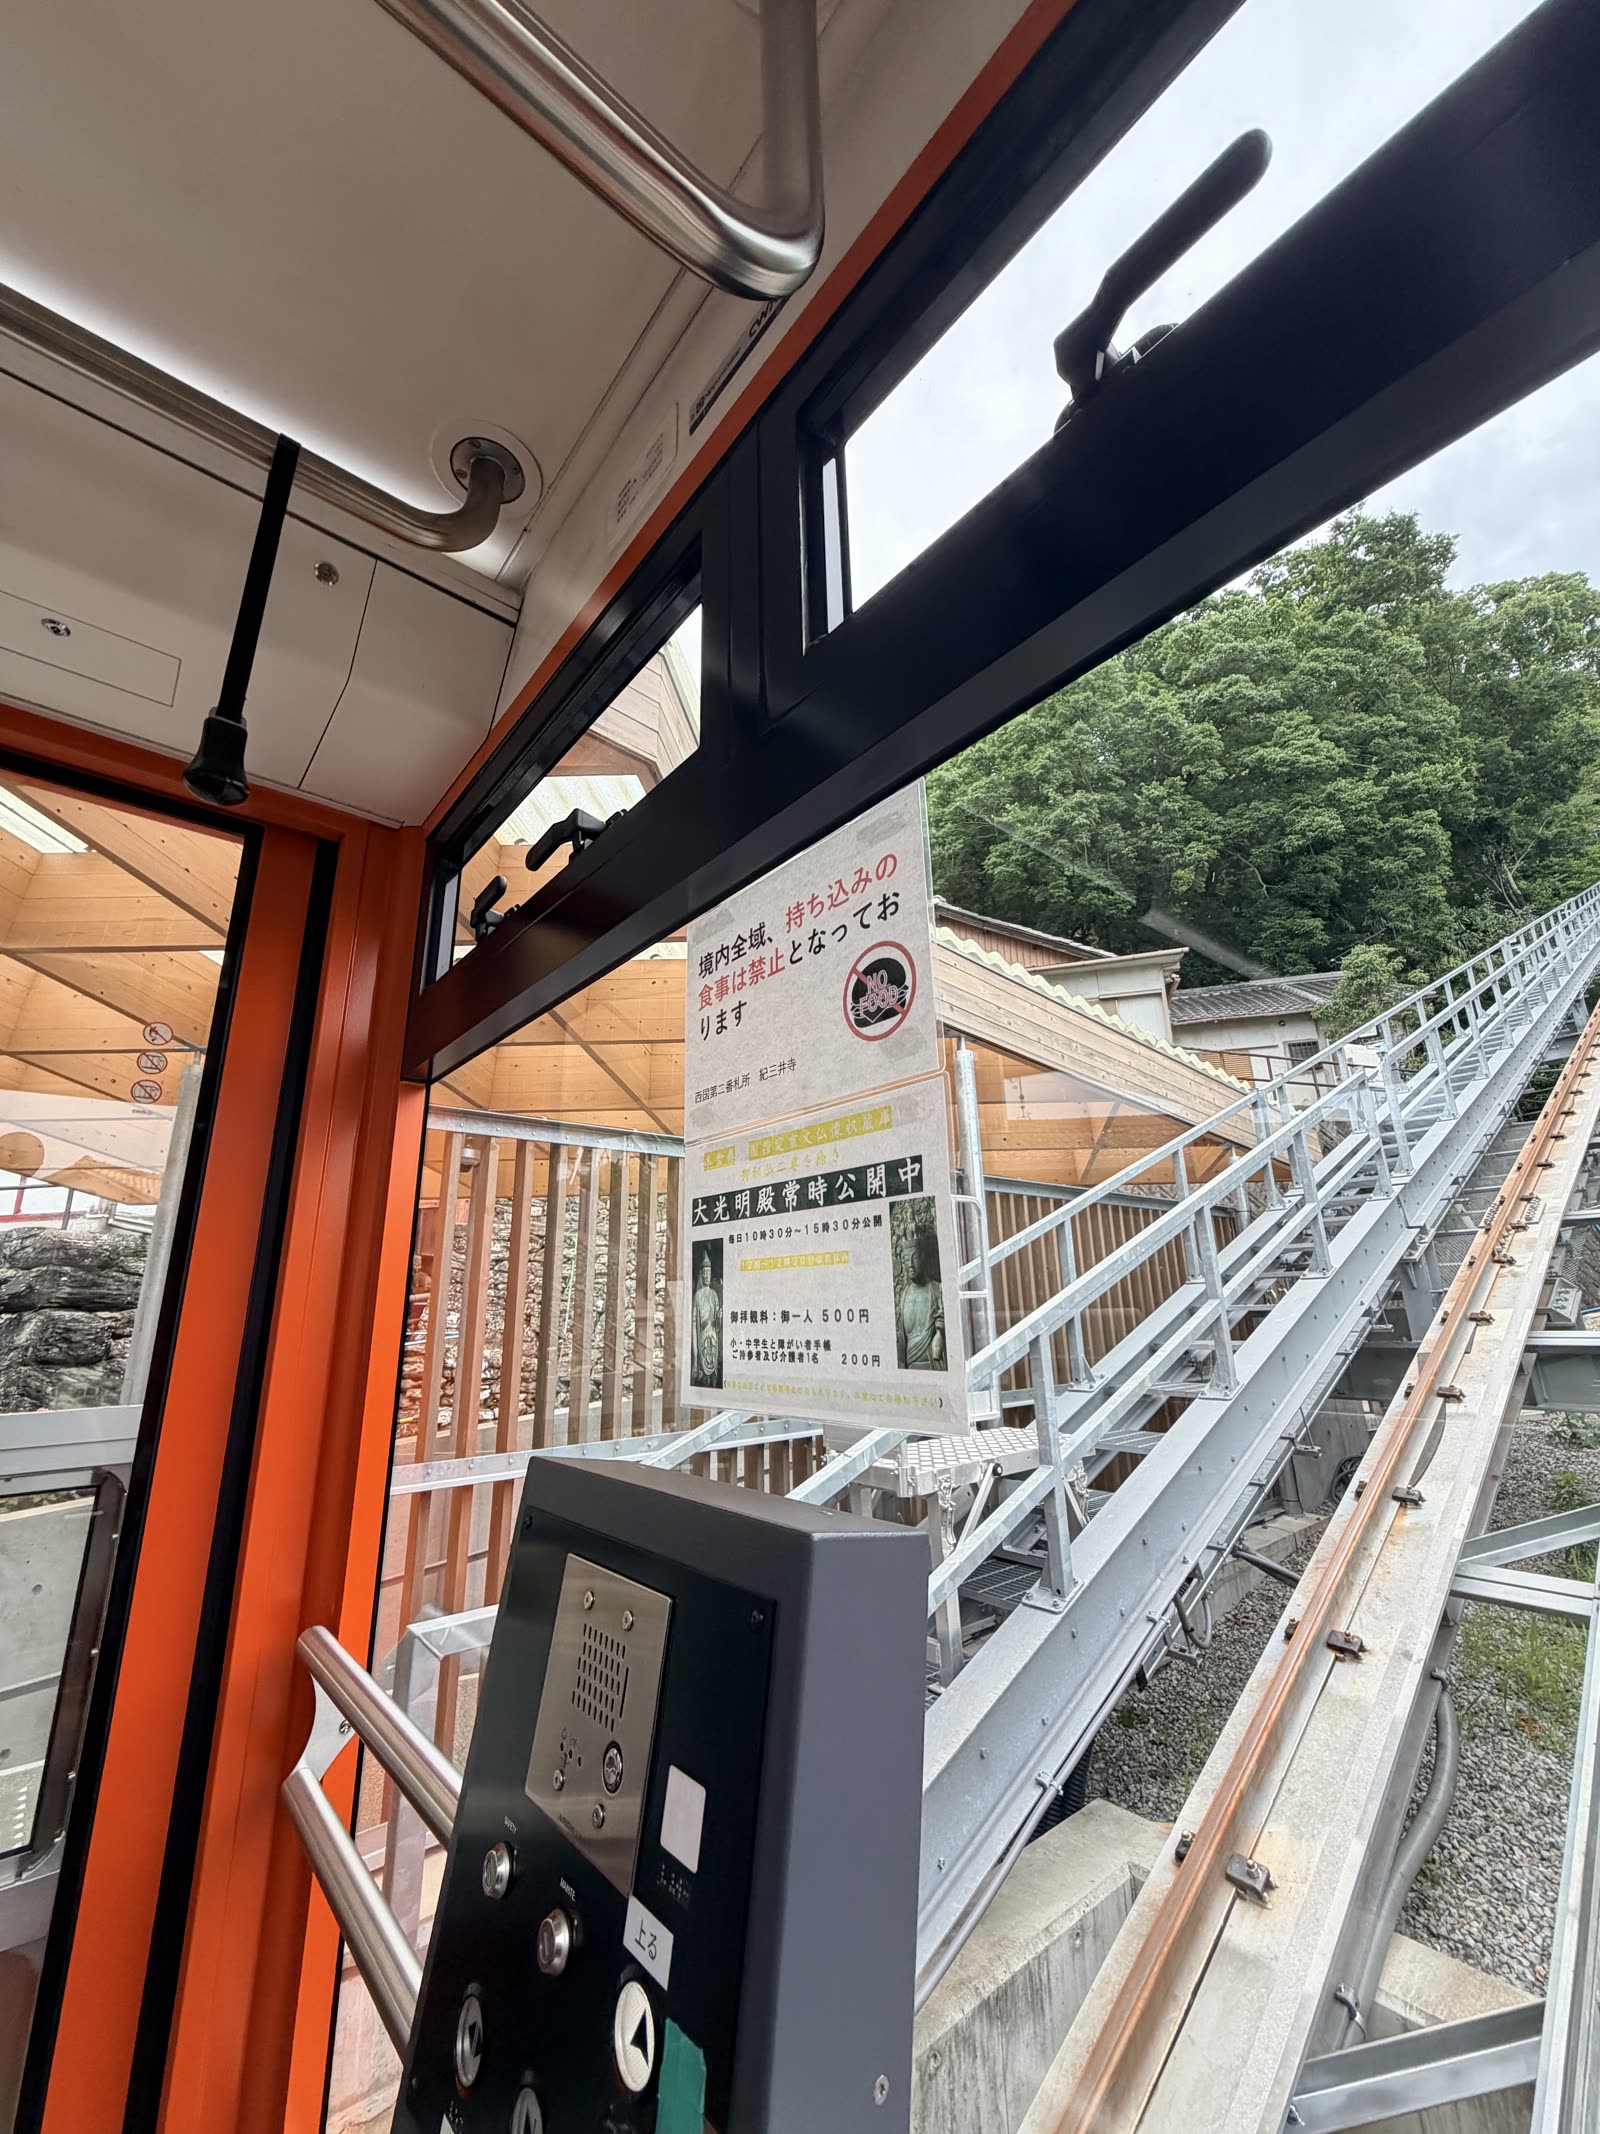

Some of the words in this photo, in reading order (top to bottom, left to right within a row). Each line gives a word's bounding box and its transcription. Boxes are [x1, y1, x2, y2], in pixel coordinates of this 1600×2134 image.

[698, 853, 898, 979] 境内全域、持ち込みの
[698, 892, 901, 1012] 食事は禁止となってお
[859, 985, 899, 1017] FOOD
[866, 969, 888, 994] NO
[699, 1000, 748, 1042] ります
[694, 1072, 751, 1104] 西国第二番札所
[759, 1057, 797, 1082] 紀三井寺
[693, 1158, 922, 1225] 大光明殿常時公開中
[822, 1308, 870, 1324] 500円
[841, 1353, 881, 1367] 200円
[634, 1919, 658, 1961] 上る
